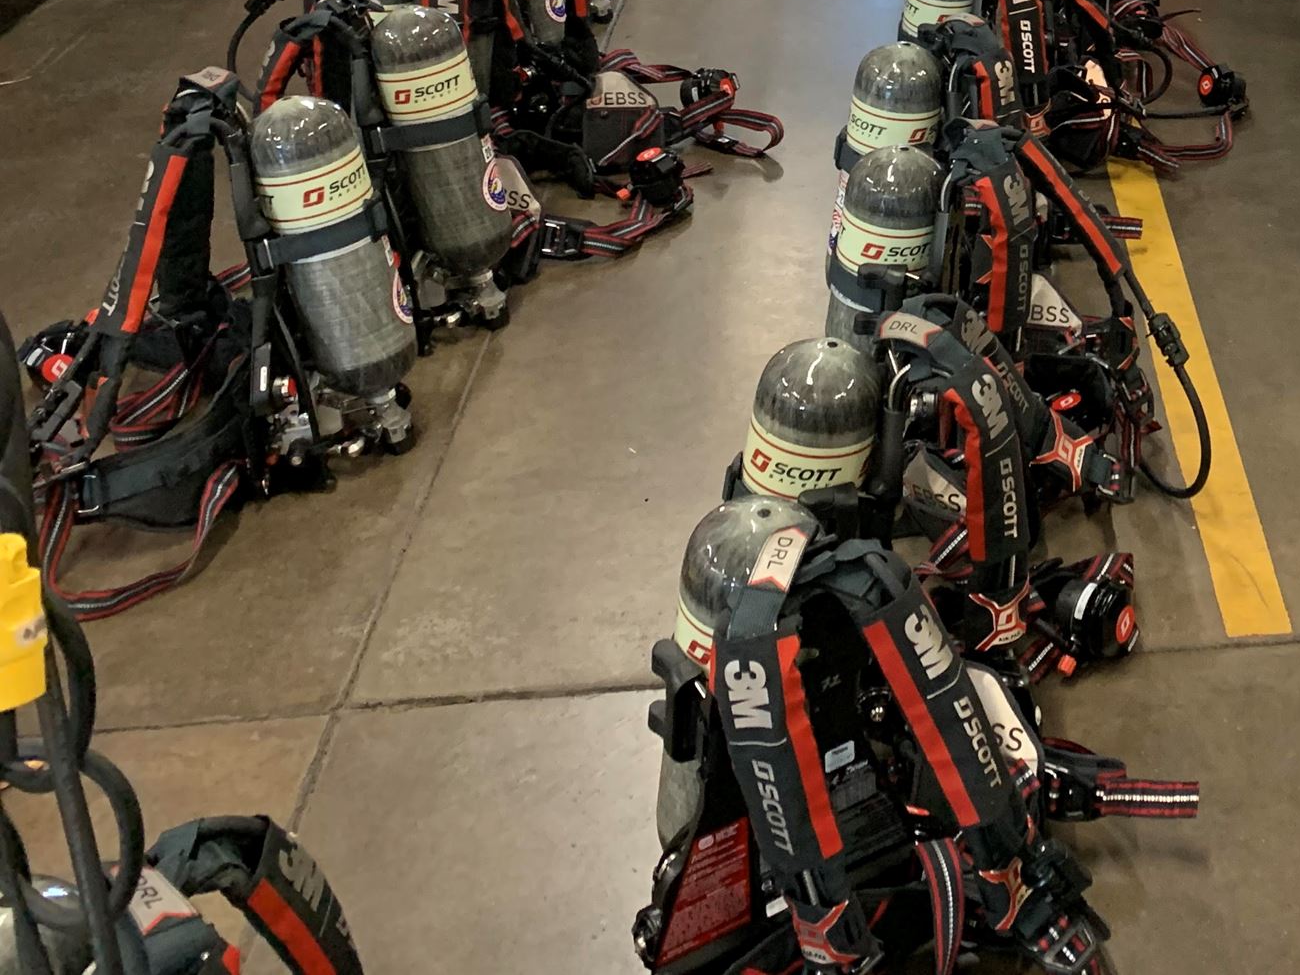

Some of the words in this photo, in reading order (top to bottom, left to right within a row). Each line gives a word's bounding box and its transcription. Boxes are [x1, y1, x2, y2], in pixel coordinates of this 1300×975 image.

[1020, 32, 1035, 74] SCOTT
[414, 74, 460, 98] SCOTT
[994, 60, 1016, 106] 3M
[850, 113, 887, 136] SCOTT
[1003, 172, 1030, 225] 3M
[886, 241, 932, 257] SCOT
[1017, 263, 1029, 313] SCOTT
[888, 319, 919, 335] DRL
[961, 309, 994, 355] 3M
[971, 374, 1009, 440] 3M
[1004, 376, 1030, 413] SCOTT
[772, 461, 842, 482] SCOTT
[1001, 477, 1018, 538] SCOTT
[767, 536, 793, 570] DRL
[903, 605, 954, 680] 3M
[723, 658, 773, 730] 3M
[962, 718, 1003, 787] SCOTT
[757, 782, 795, 856] SCOTT
[278, 845, 327, 914] 3M
